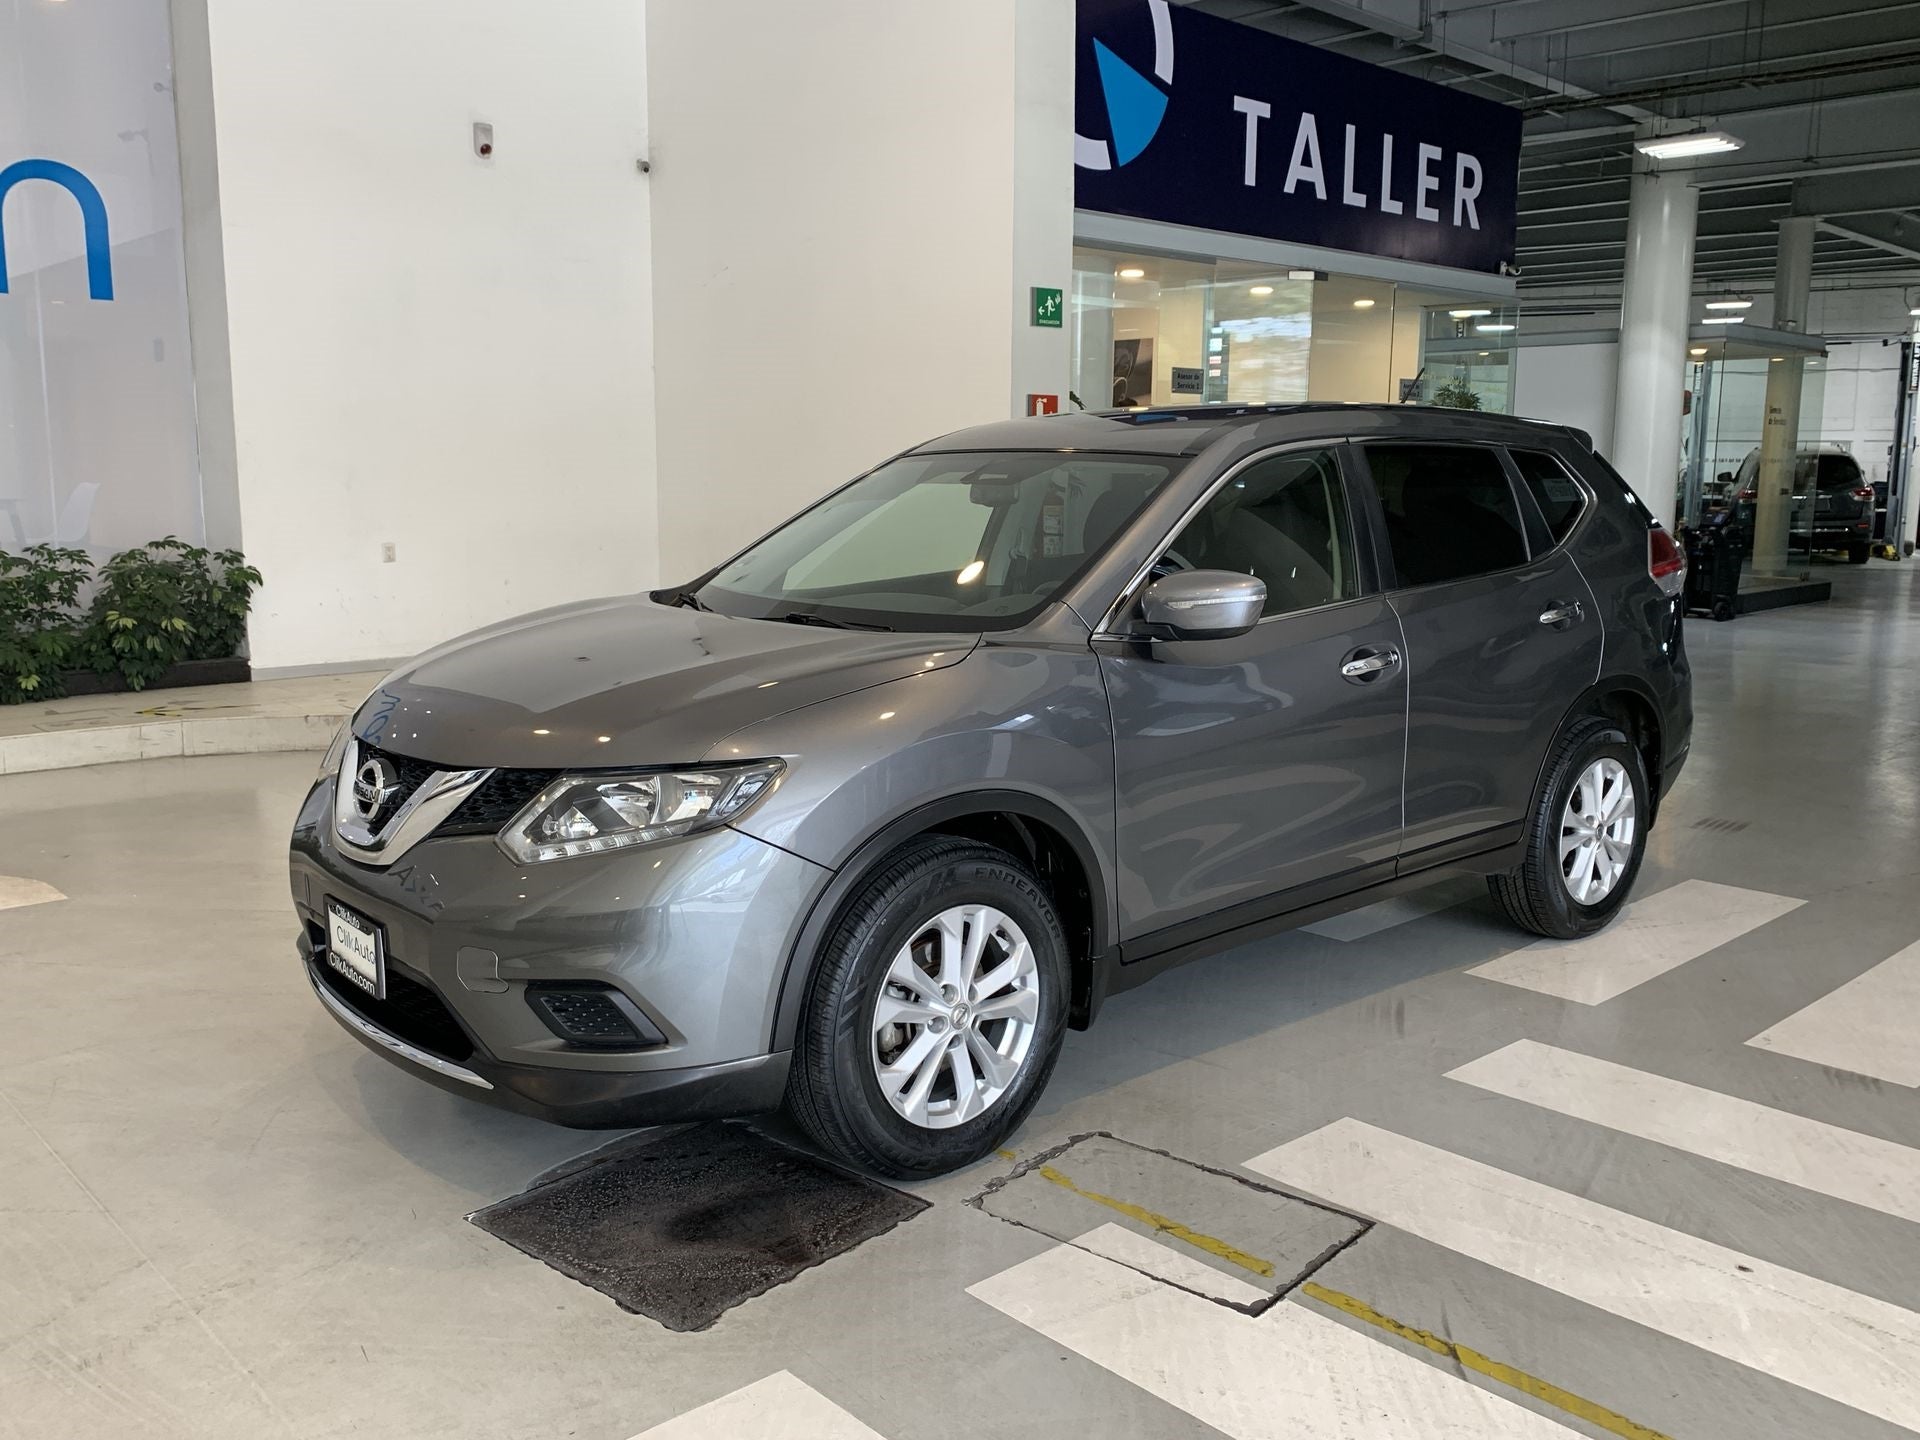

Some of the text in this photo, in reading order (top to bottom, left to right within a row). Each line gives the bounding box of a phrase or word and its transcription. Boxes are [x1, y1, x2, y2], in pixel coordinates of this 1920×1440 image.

[1233, 95, 1483, 230] TALLER
[974, 867, 1061, 939] ENDEAVOR
[329, 951, 376, 996] ClikAuto.com
[336, 925, 376, 965] ClikAuto
